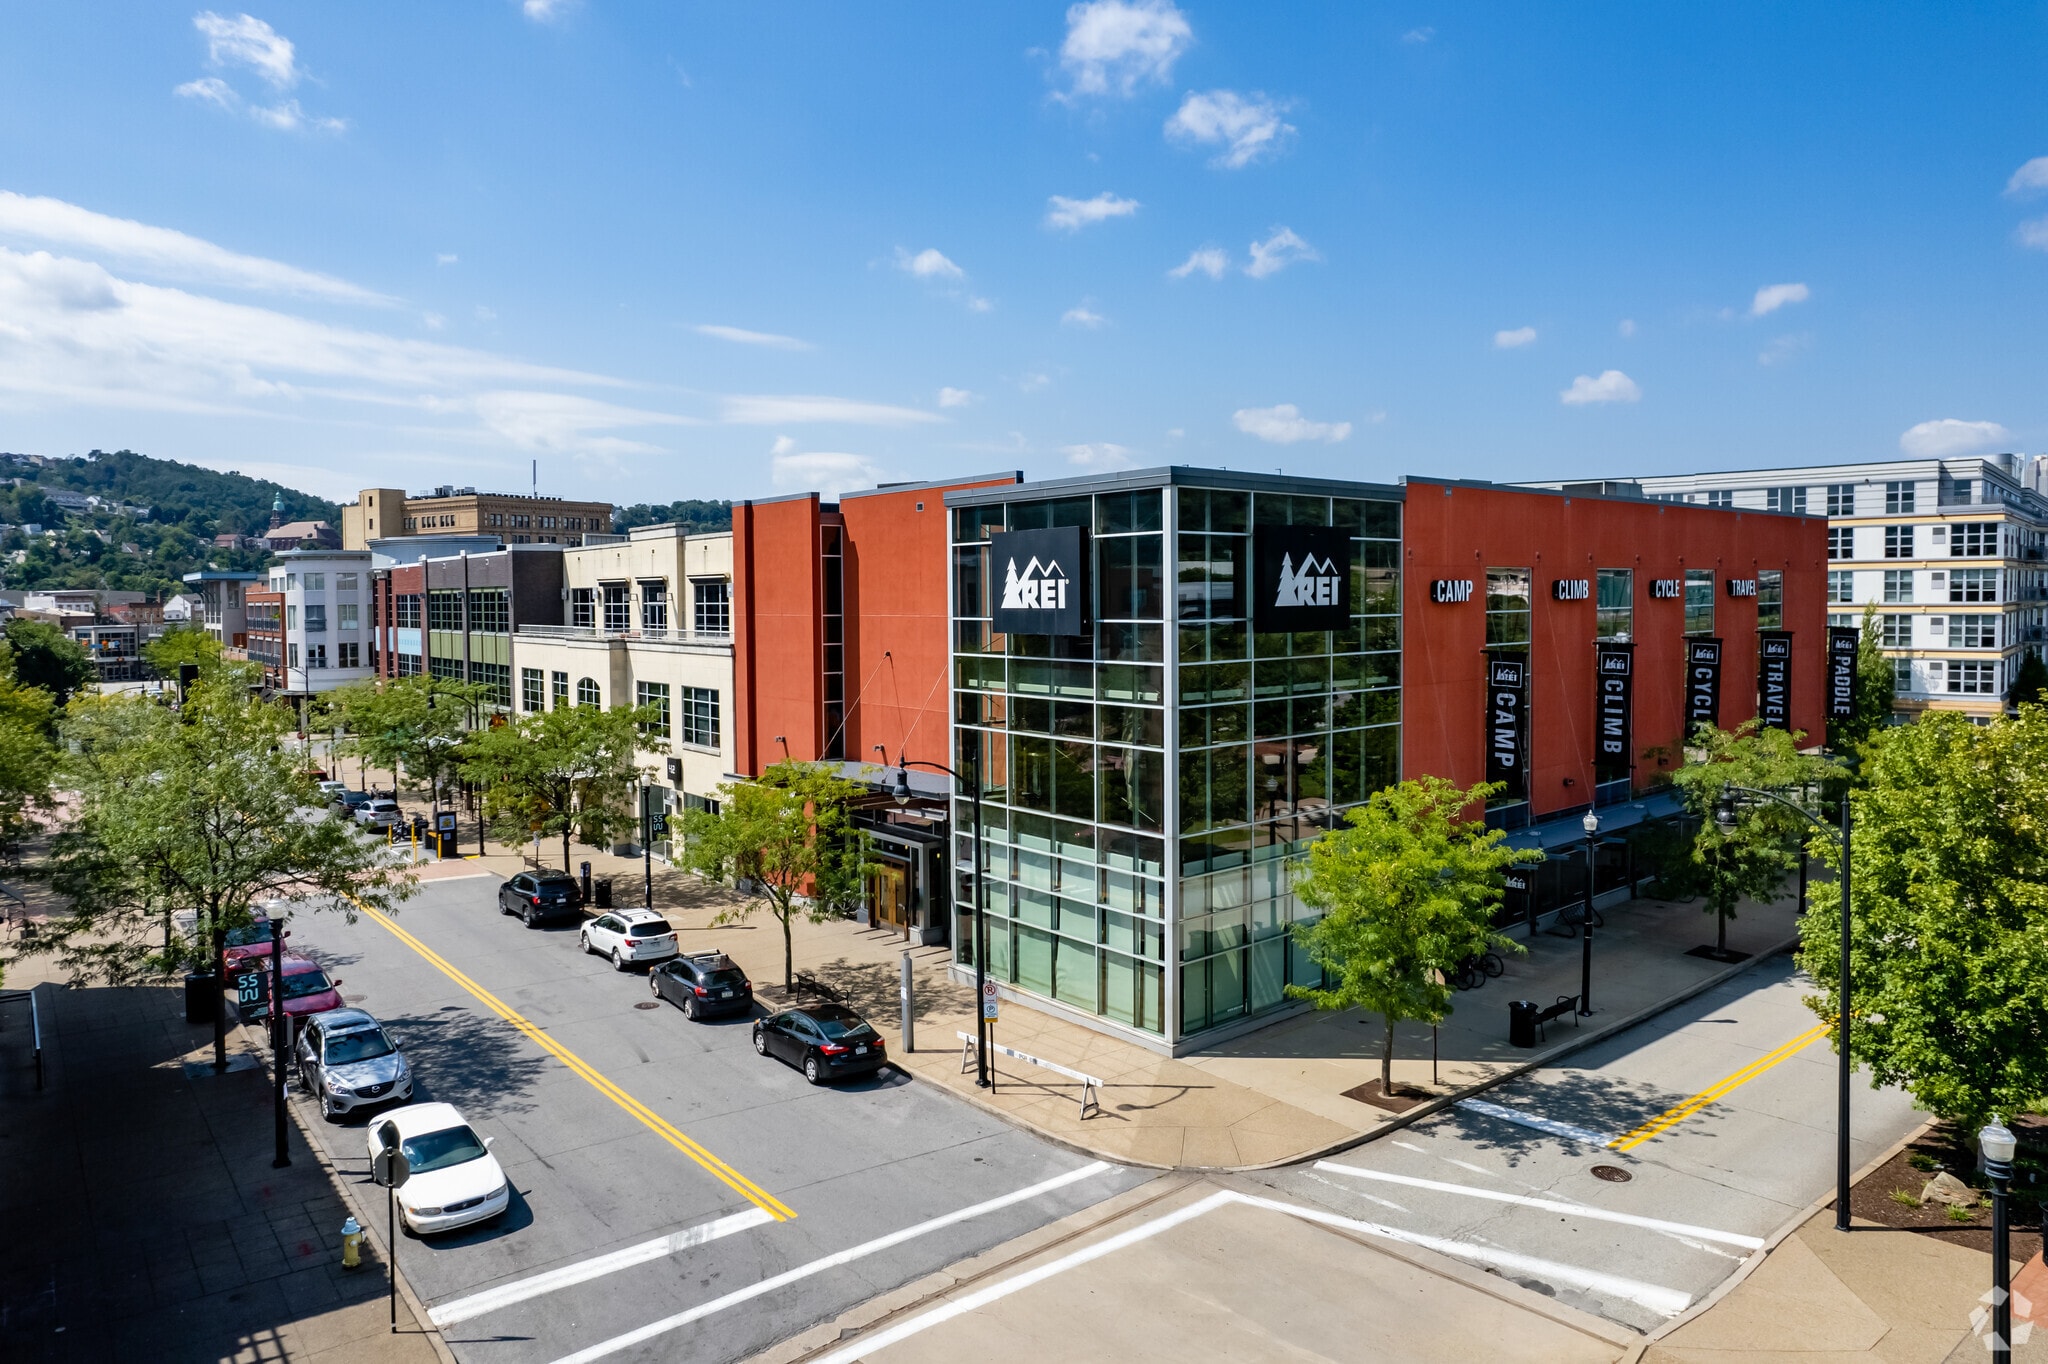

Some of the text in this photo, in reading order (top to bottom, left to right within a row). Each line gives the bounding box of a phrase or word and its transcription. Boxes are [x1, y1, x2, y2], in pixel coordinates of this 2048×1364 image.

[1437, 580, 1473, 602] CAMP
[1558, 579, 1589, 600] CLIMB
[1655, 579, 1680, 598] CYCLE
[1732, 579, 1757, 597] TRAVEL
[1692, 667, 1713, 729] CYCL
[1766, 661, 1784, 725] TRAVEL
[1834, 656, 1851, 714] PADDLE
[1494, 693, 1517, 767] CAMP
[1603, 680, 1624, 753] CLIMB
[238, 974, 258, 989] SS
